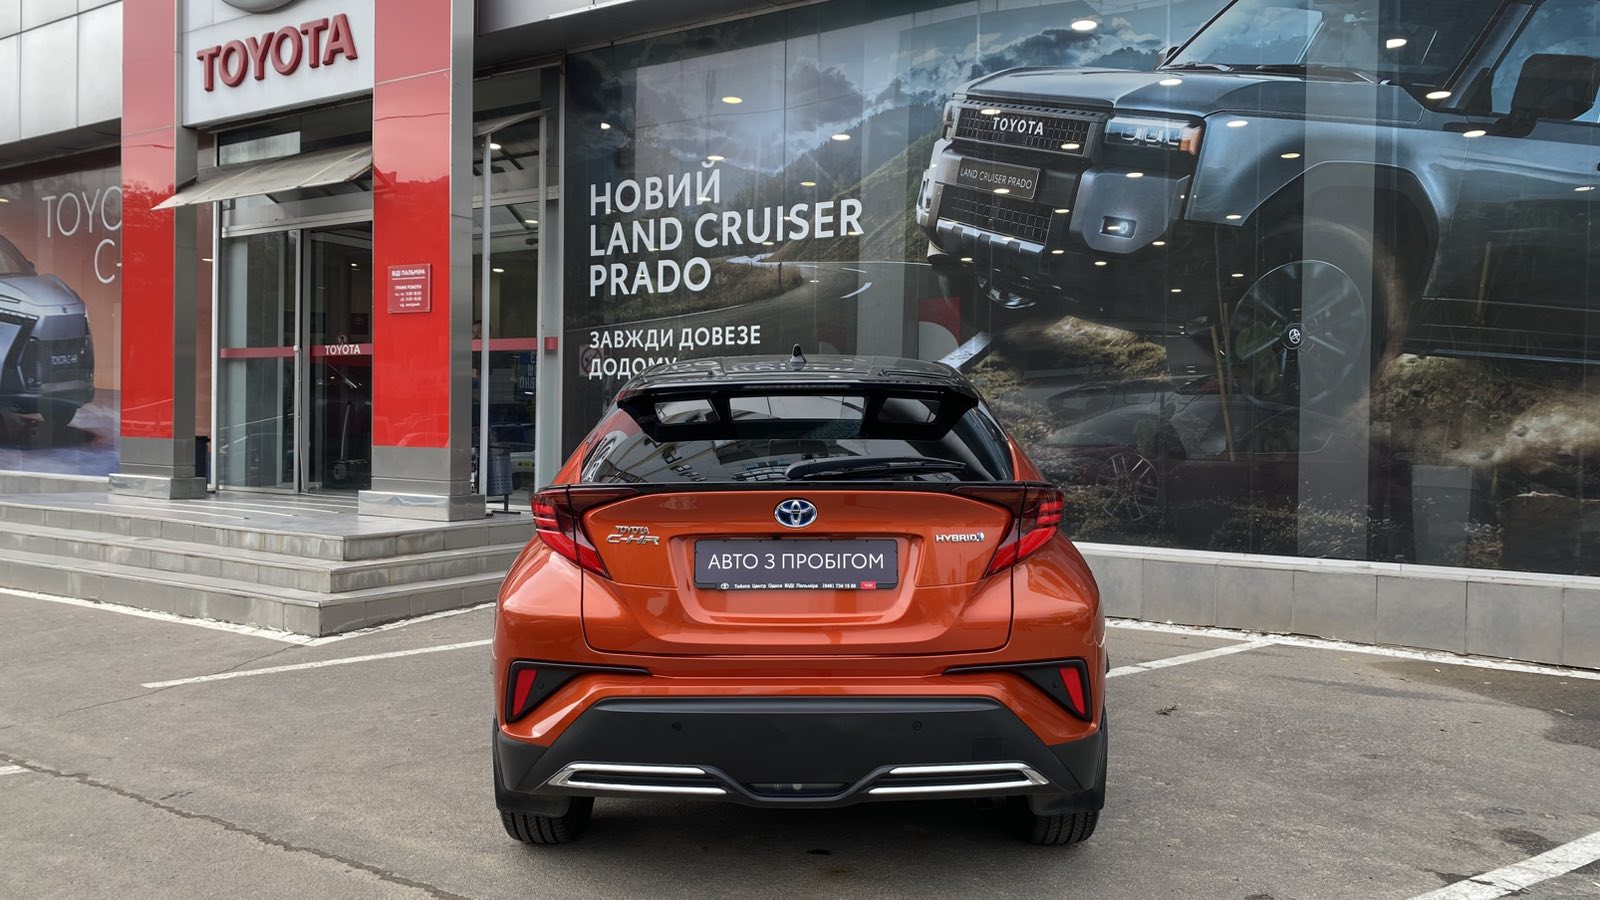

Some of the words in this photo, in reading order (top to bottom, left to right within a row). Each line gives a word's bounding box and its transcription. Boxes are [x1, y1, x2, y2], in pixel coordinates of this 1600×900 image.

[196, 13, 358, 92] TOYOTA
[992, 117, 1044, 136] TOYOTA
[590, 159, 721, 217] НОВИЙ
[959, 168, 978, 180] LAND
[979, 171, 1007, 186] CRUISER
[1007, 175, 1033, 189] PRADO
[590, 216, 683, 257] LAND
[694, 198, 865, 249] CRUISER
[590, 257, 712, 297] PRADO
[589, 328, 674, 351] ЗАВЖДИ
[679, 325, 761, 350] ДОВЕЗЕ
[325, 344, 361, 355] TOYOTA
[606, 533, 660, 545] C-HR
[615, 525, 650, 534] TOYOTA
[935, 533, 977, 542] HYBRID
[707, 553, 759, 570] АВТО
[764, 553, 776, 570] З
[782, 553, 884, 570] ПРОБІГОМ
